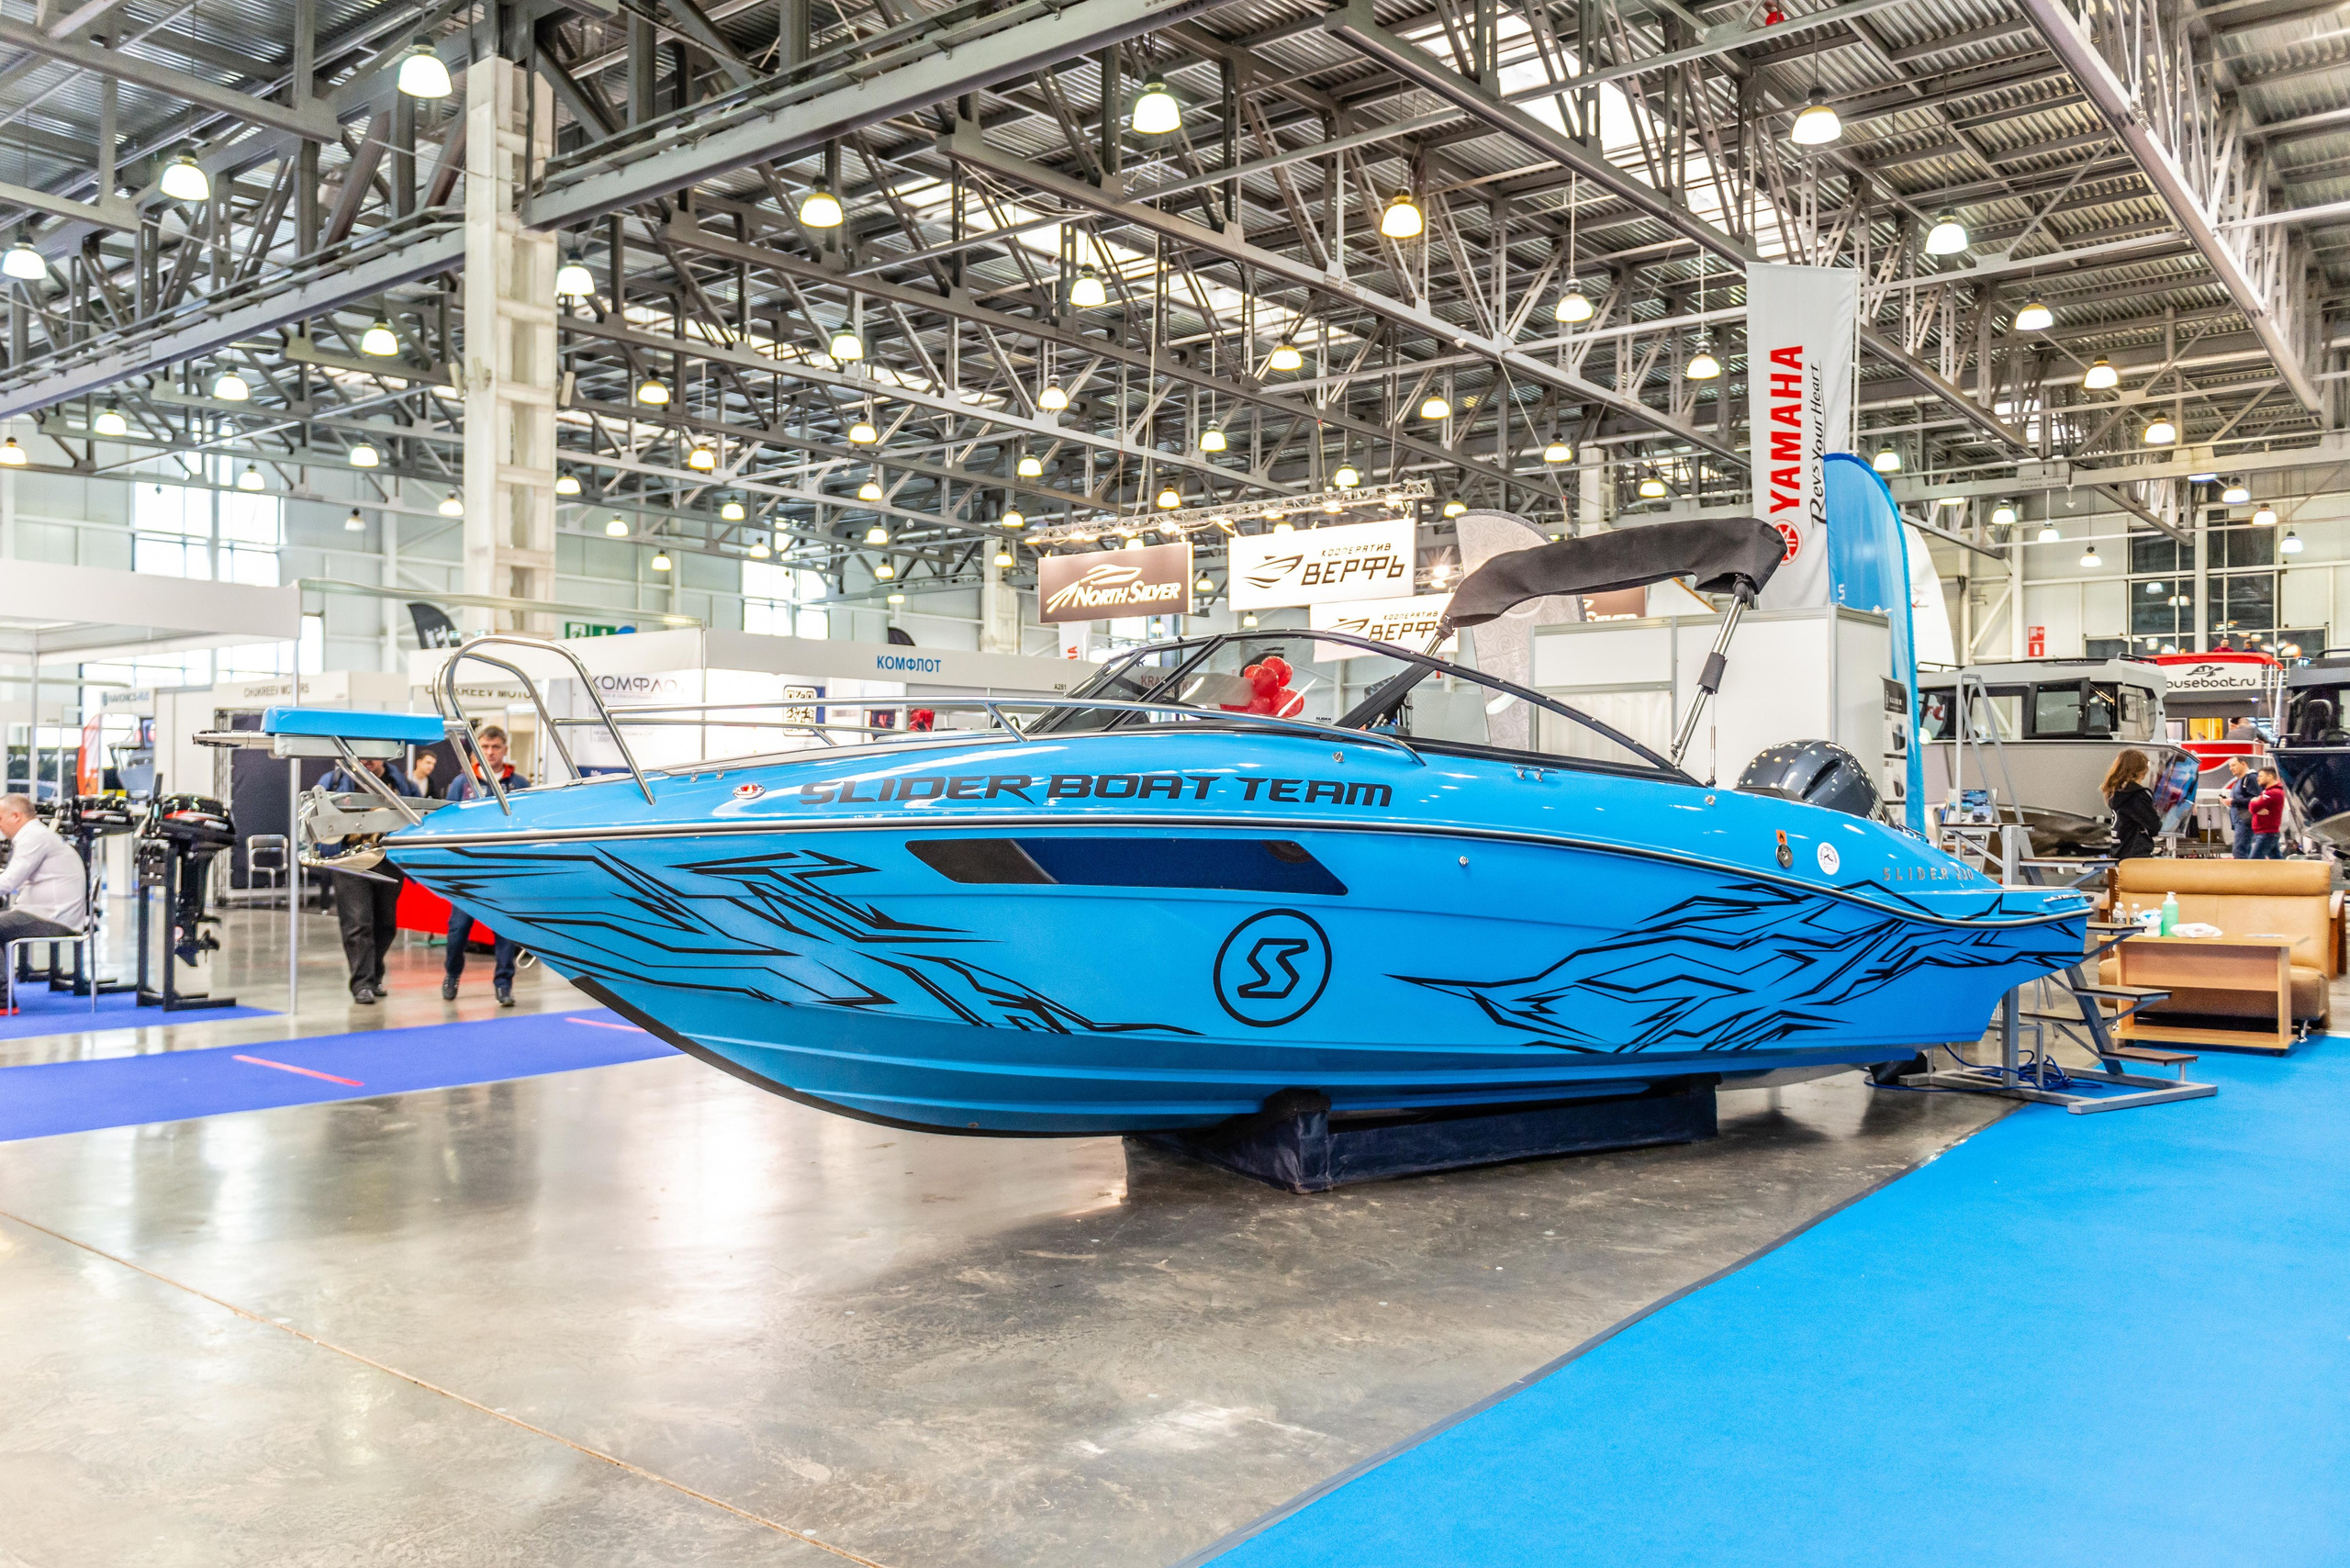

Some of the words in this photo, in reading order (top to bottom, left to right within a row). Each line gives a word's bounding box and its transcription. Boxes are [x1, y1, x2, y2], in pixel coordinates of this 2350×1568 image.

[1810, 363, 1823, 413] Heart
[1770, 345, 1804, 514] YAMAHA
[1321, 543, 1392, 557] КООПЕРАТИВ
[1301, 554, 1405, 587] ВЕРФЬ
[1369, 621, 1438, 642] ВЕРФ
[877, 655, 942, 673] КОМФЛОТ
[592, 675, 684, 693] КОМФЛО
[2166, 677, 2256, 689] ouseboat.ru
[800, 774, 1036, 806] SLIDER
[1046, 775, 1222, 801] BOAT
[1235, 777, 1393, 808] TEAM
[1883, 867, 1949, 881] SLIDER
